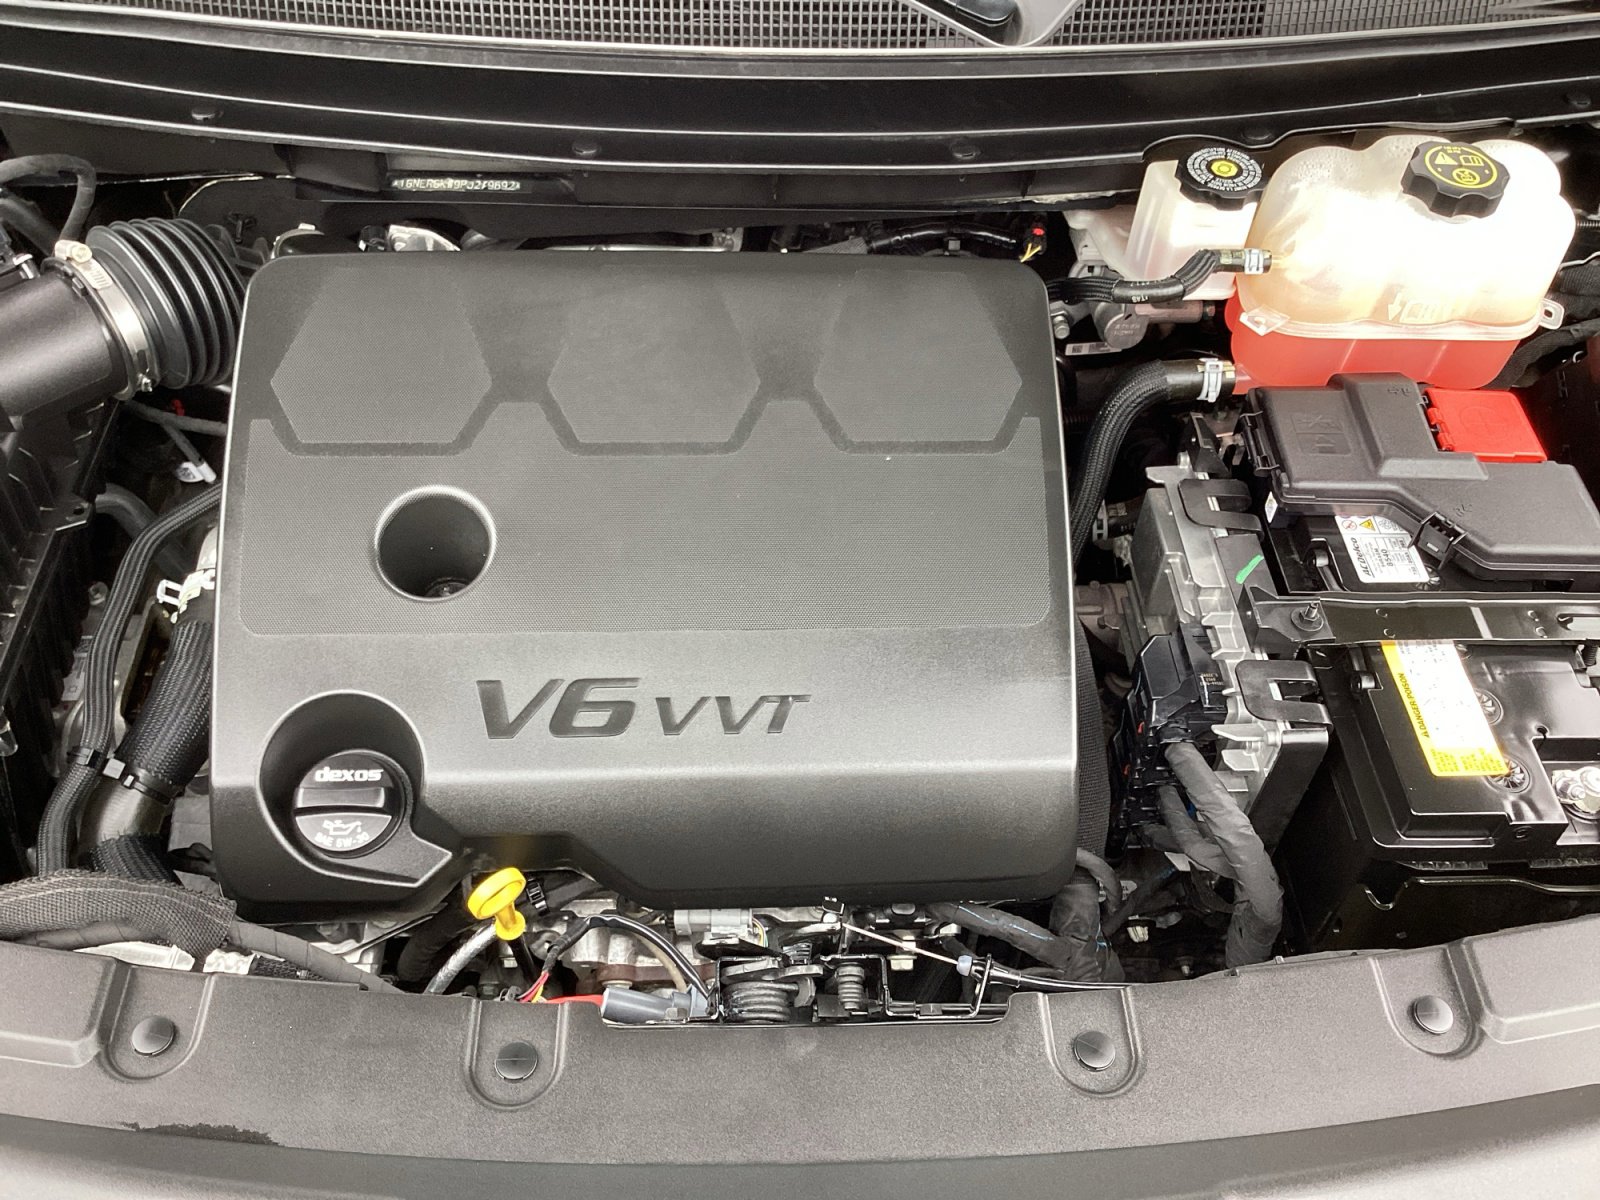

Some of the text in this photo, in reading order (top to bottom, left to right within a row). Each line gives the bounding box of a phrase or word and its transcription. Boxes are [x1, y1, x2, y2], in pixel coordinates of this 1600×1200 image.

[1351, 537, 1372, 577] ACDelco
[476, 677, 812, 739] V6 VVT
[1398, 672, 1427, 731] DANGER POISON
[314, 766, 384, 782] dexos
